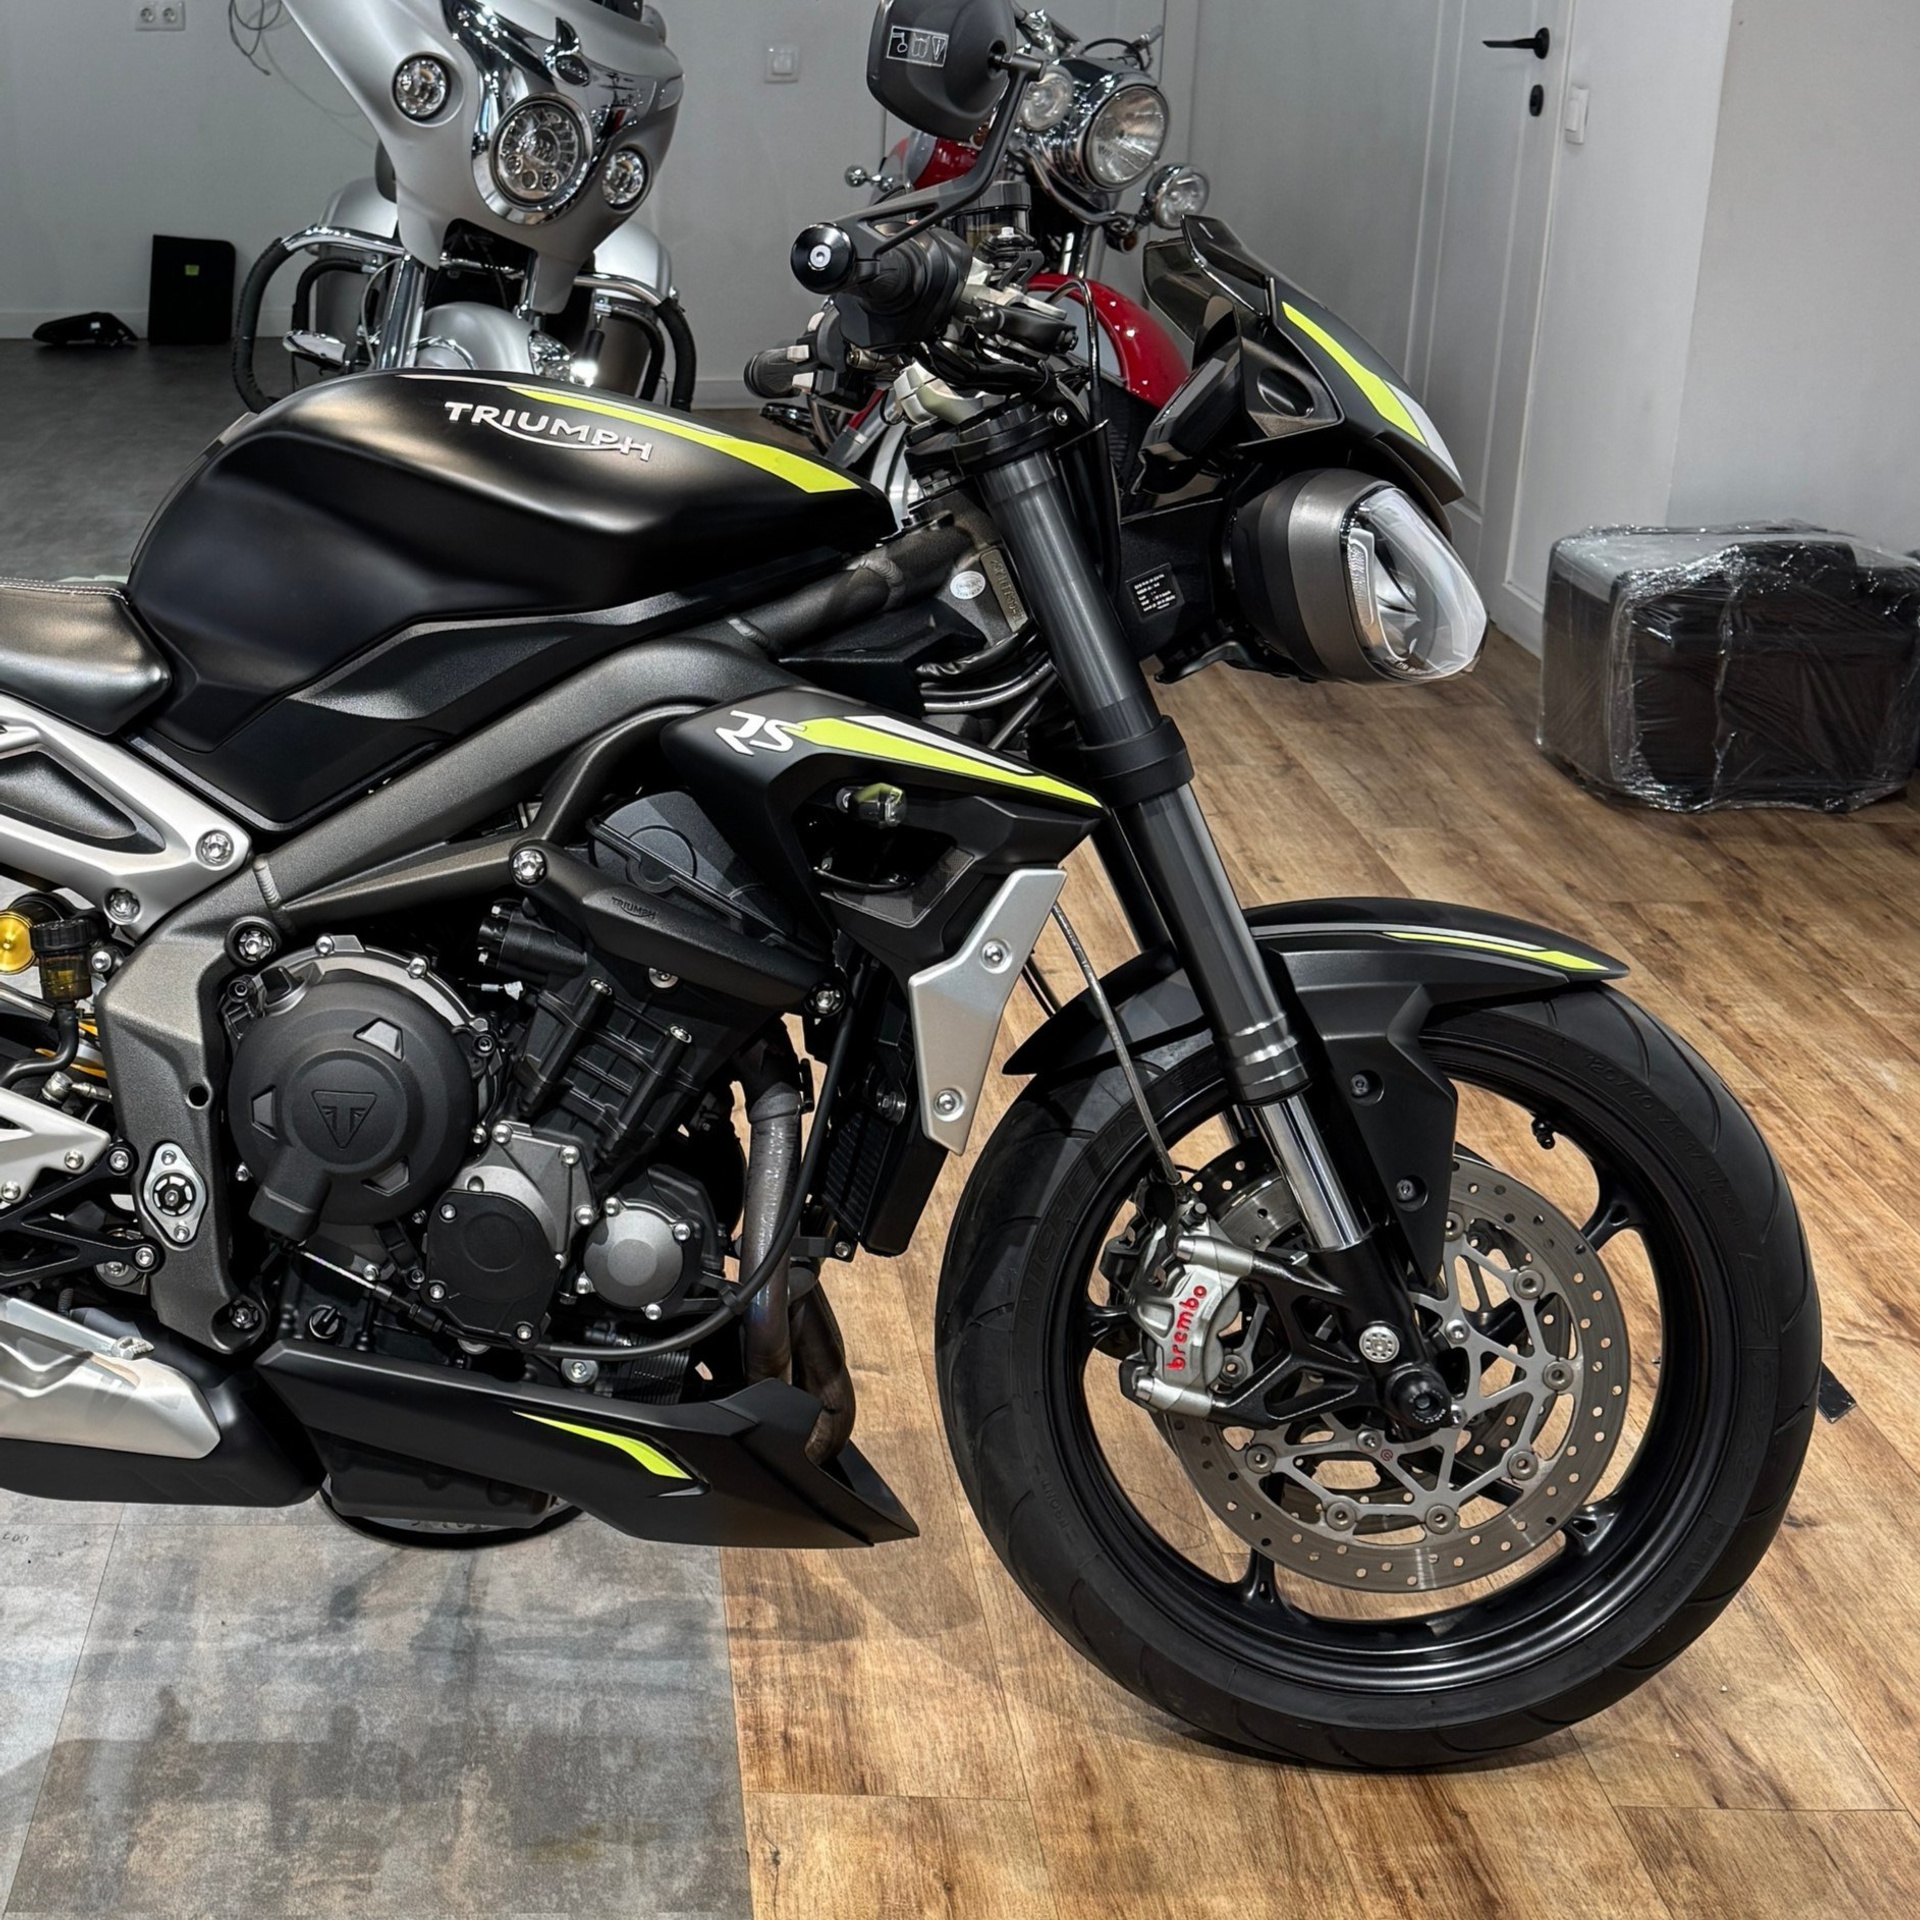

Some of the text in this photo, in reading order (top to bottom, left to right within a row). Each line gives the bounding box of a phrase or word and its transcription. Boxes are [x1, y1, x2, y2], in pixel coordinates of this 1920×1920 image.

[445, 401, 653, 462] TRIUMPH
[715, 710, 806, 756] RS
[611, 897, 656, 919] TRIUMPH
[1016, 1105, 1145, 1326] MICHELIN
[1166, 1285, 1207, 1371] brembo
